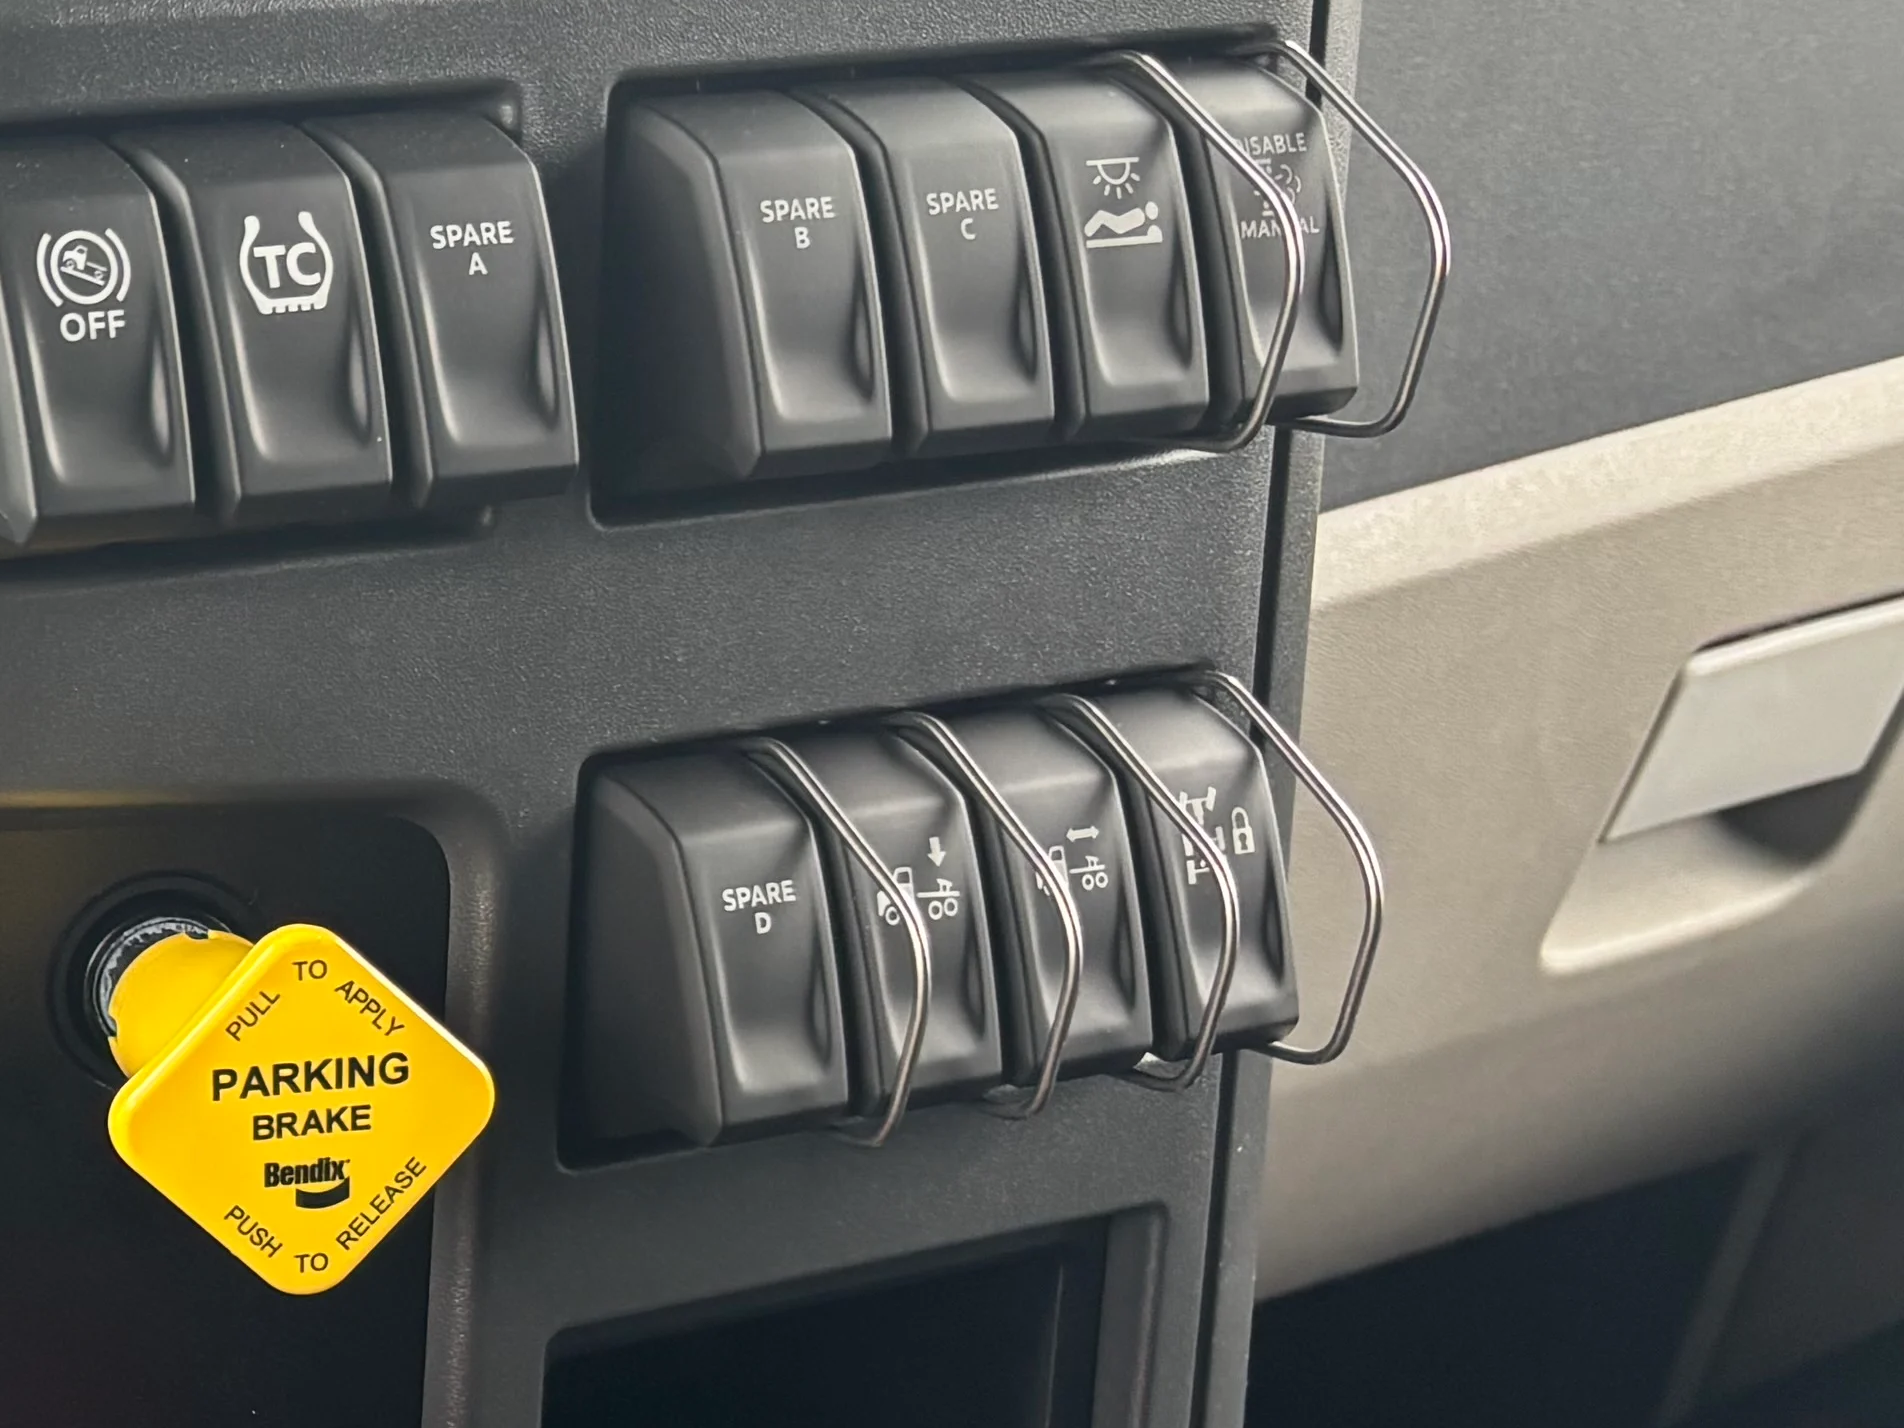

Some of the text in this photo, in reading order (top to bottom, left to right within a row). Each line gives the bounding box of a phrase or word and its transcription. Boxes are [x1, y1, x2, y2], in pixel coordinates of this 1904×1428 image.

[759, 194, 836, 224] SPARE
[925, 187, 1000, 216] SPARE
[429, 220, 515, 249] SPARE
[793, 226, 811, 251] B
[960, 218, 977, 241] C
[252, 242, 323, 290] TC
[467, 253, 489, 276] A
[60, 309, 126, 343] OFF
[722, 879, 797, 912] SPARE
[755, 908, 773, 934] D
[225, 959, 405, 1041] PULL TO APPLY
[212, 1053, 410, 1101] PARKING
[252, 1105, 371, 1141] BRAKE
[264, 1157, 347, 1188] Bendix
[224, 1156, 427, 1273] PUSH TO RELEASE
